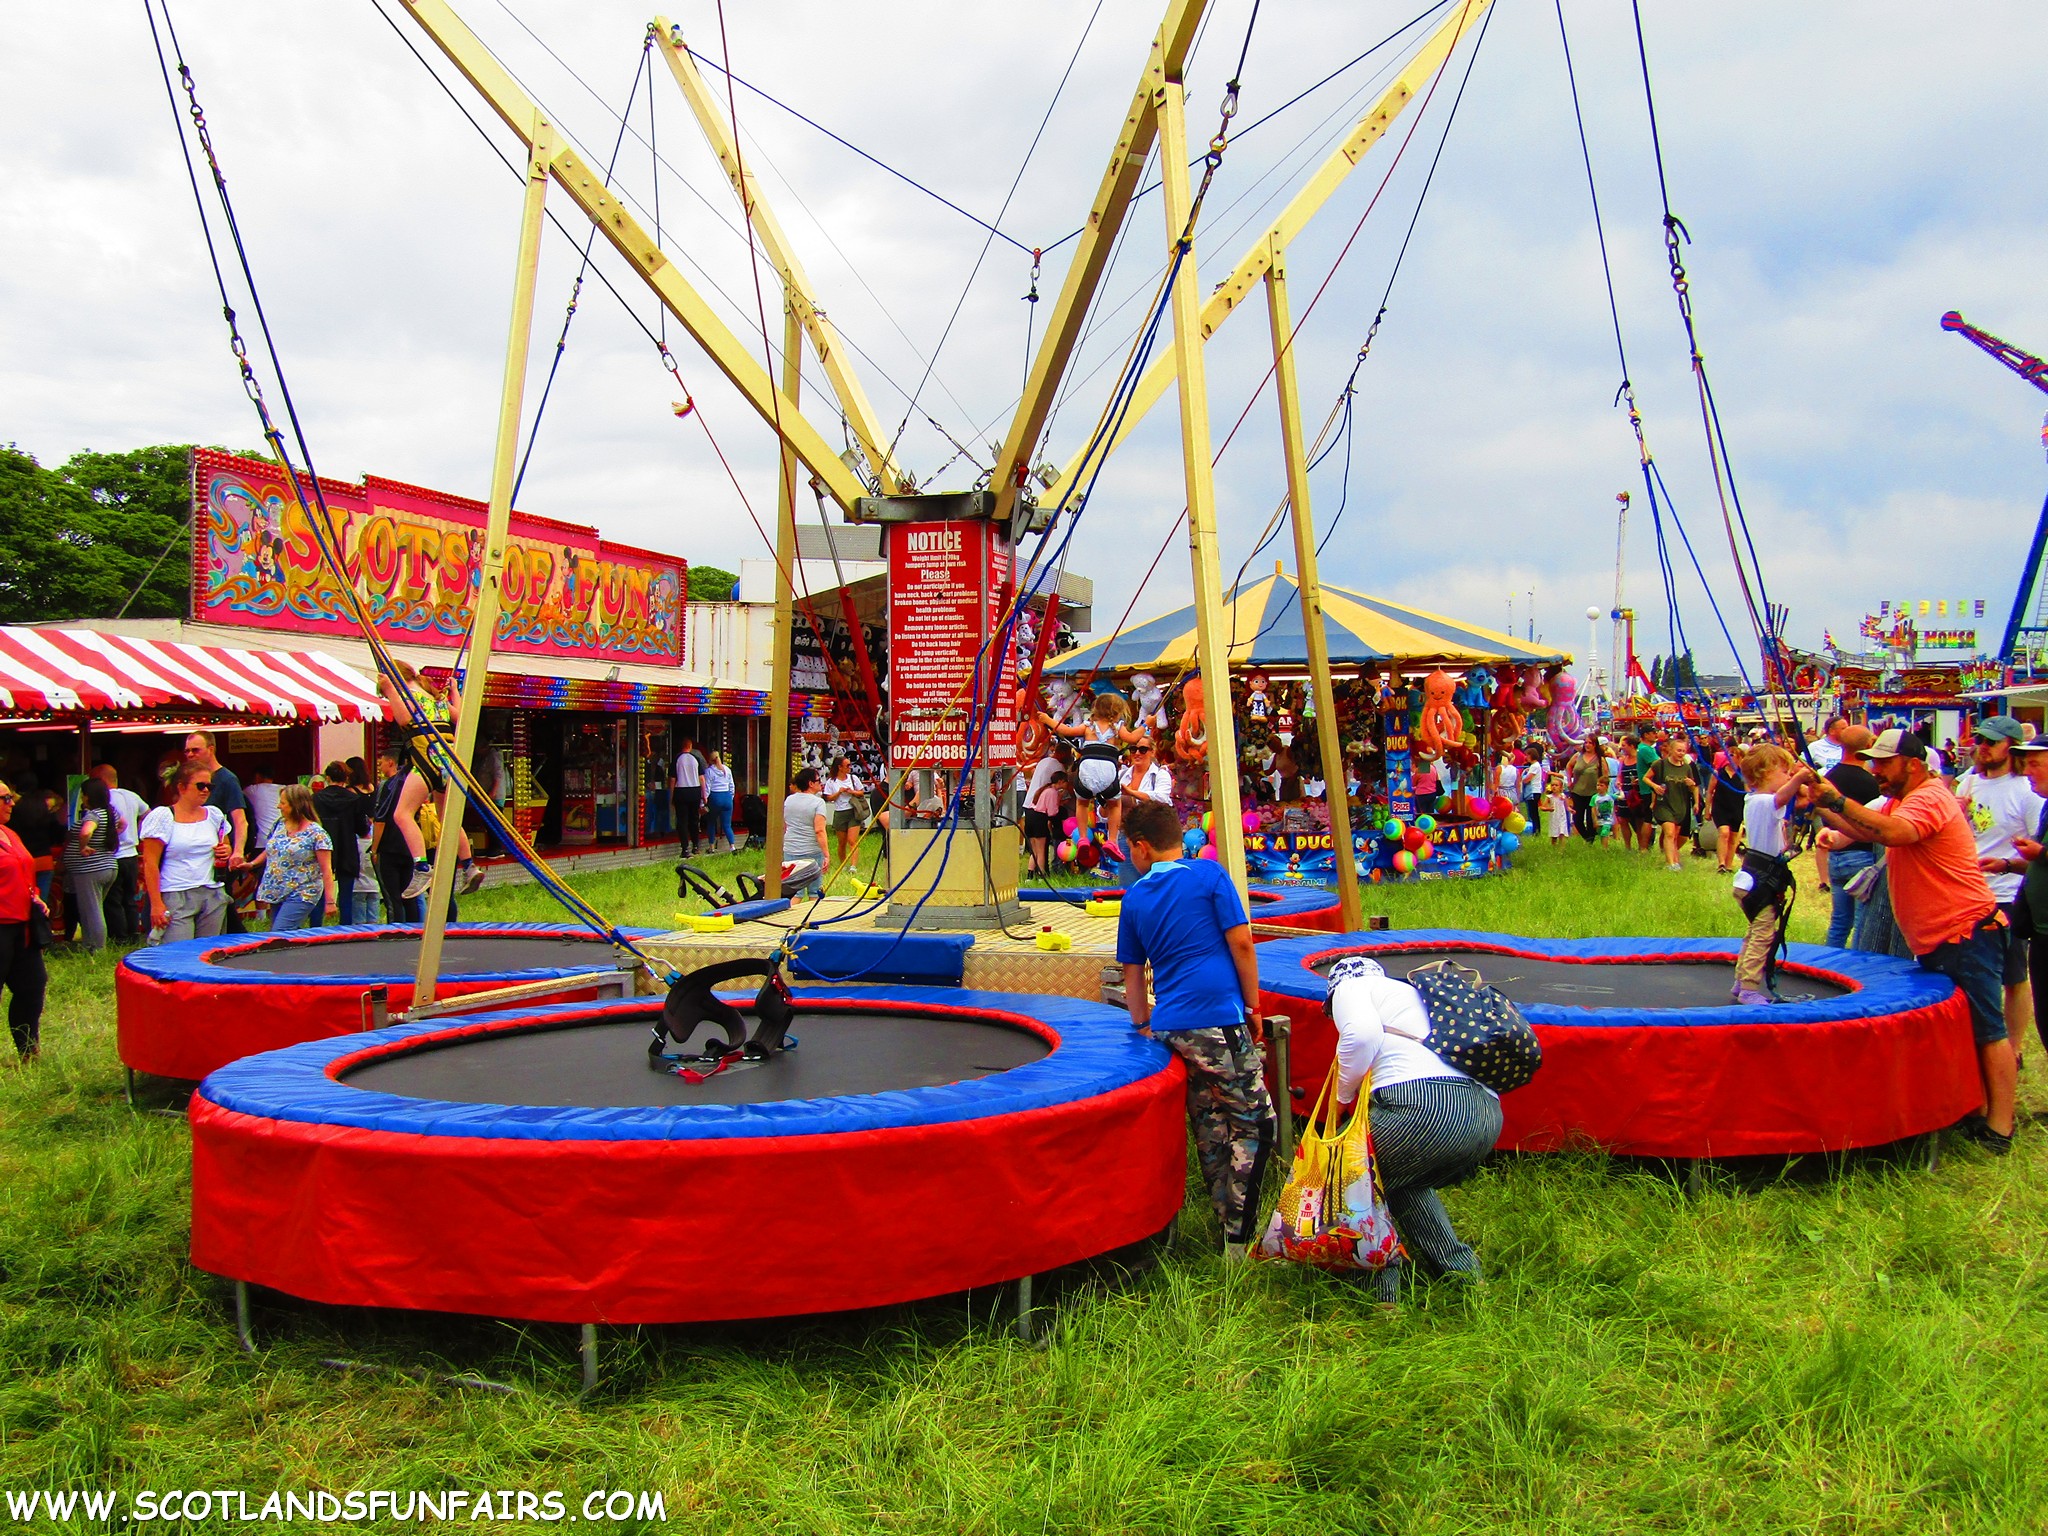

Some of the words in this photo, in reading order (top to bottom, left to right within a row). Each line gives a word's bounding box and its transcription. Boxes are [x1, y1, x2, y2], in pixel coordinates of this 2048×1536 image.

[907, 531, 962, 551] NOTICE
[282, 500, 469, 603] SLOTS
[500, 545, 553, 617] OF
[573, 557, 650, 629] FUN
[921, 569, 950, 579] Please
[1390, 696, 1407, 711] OK
[895, 720, 940, 731] Available
[942, 720, 957, 731] for
[959, 720, 980, 731] he
[1394, 716, 1401, 730] A
[1386, 736, 1408, 750] DUCK
[1393, 802, 1410, 812] PRIZE
[1427, 830, 1443, 844] OK
[1447, 828, 1458, 842] A
[1464, 825, 1487, 840] DUCK
[1244, 836, 1265, 850] OK
[1273, 836, 1287, 850] A
[1296, 835, 1334, 850] DUC
